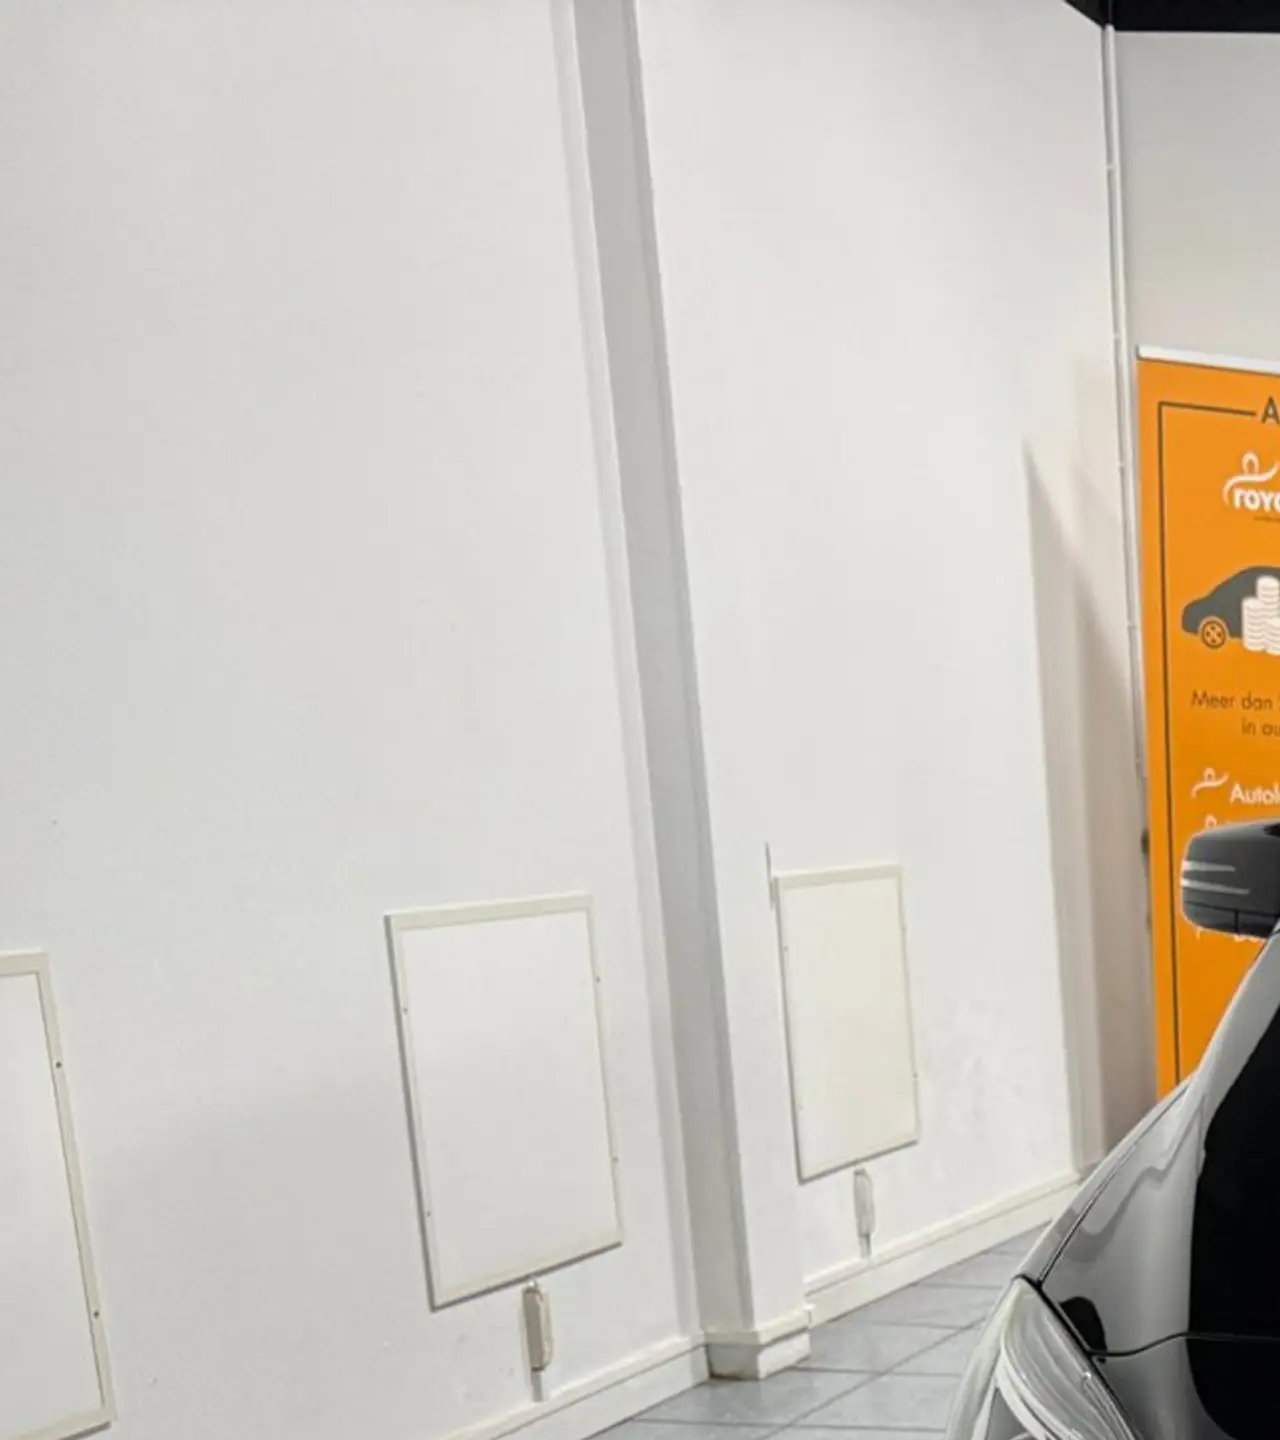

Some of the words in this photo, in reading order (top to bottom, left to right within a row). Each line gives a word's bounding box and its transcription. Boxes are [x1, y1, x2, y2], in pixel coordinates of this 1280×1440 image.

[1191, 690, 1235, 709] Meer
[1241, 691, 1273, 712] dan
[1241, 716, 1256, 736] in
